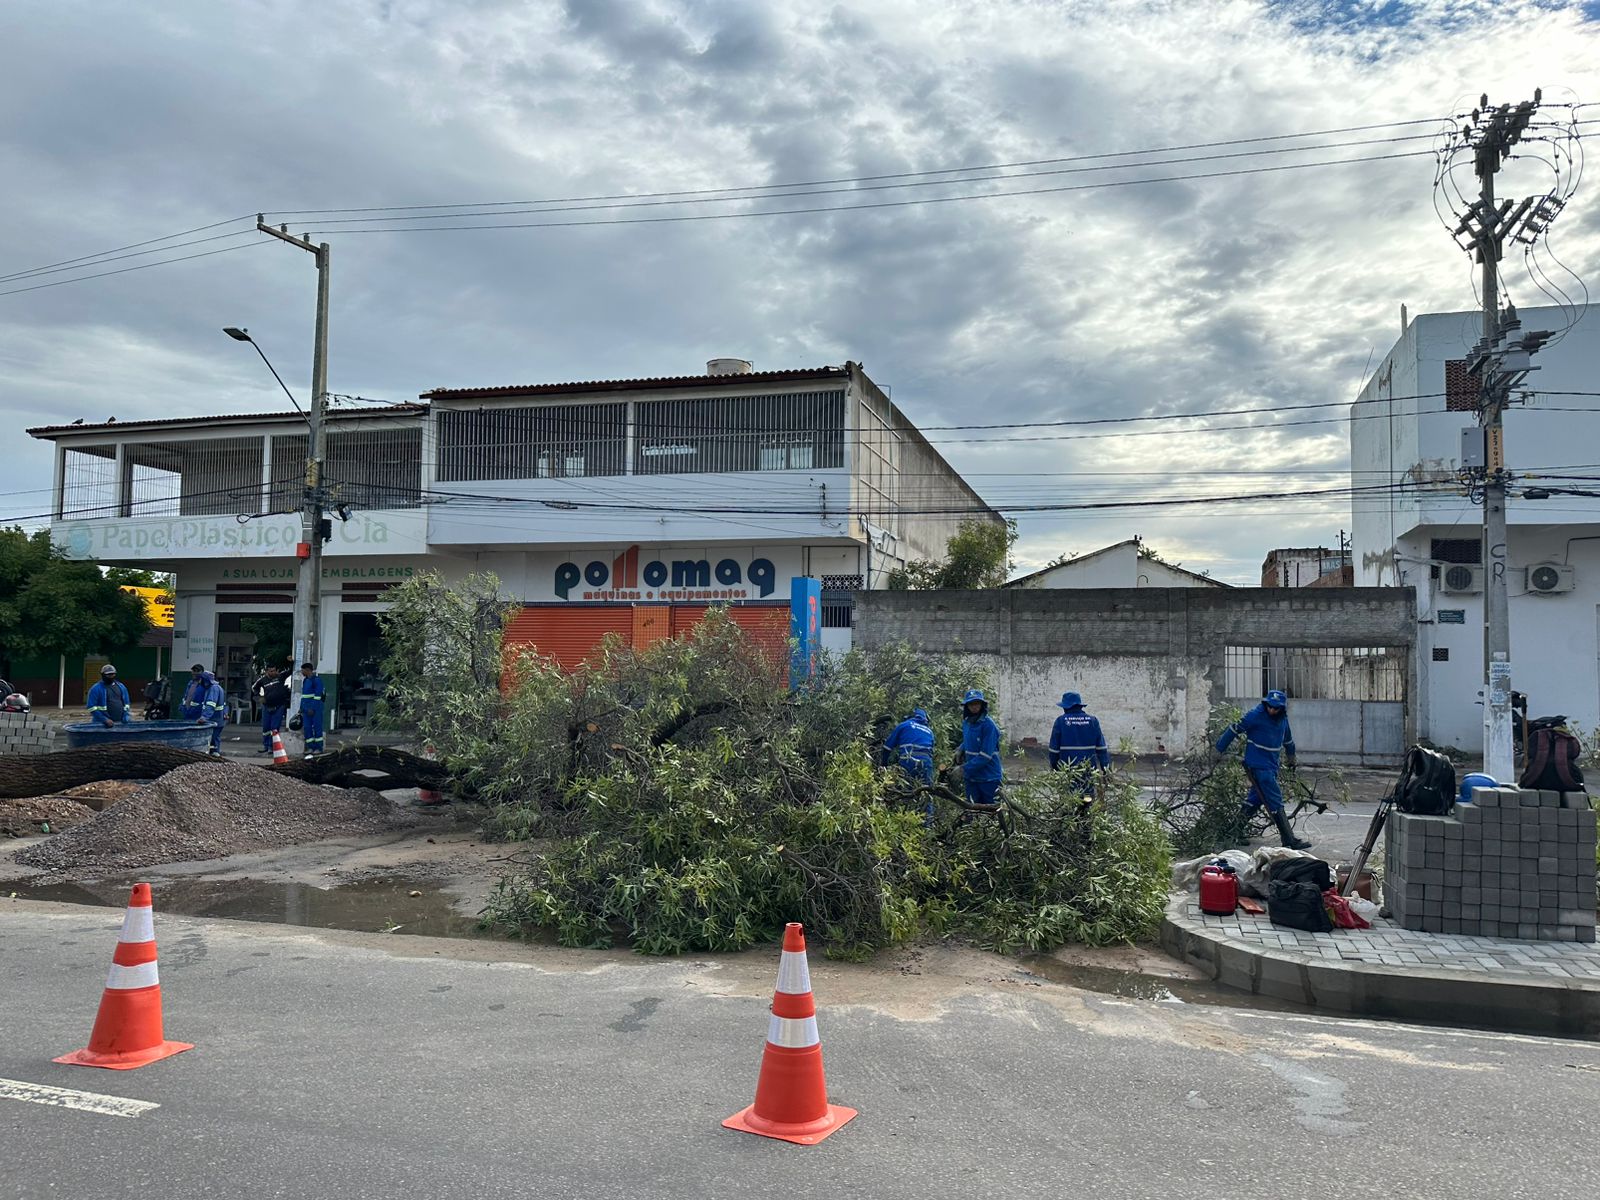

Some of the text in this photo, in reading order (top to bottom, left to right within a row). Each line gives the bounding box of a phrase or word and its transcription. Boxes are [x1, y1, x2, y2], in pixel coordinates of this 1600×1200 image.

[340, 517, 389, 544] Cia
[223, 567, 414, 578] A SUA LOJA EMBALAGENS
[554, 545, 776, 600] pollomaq
[583, 588, 642, 600] máquinas
[660, 587, 748, 600] equipamentos
